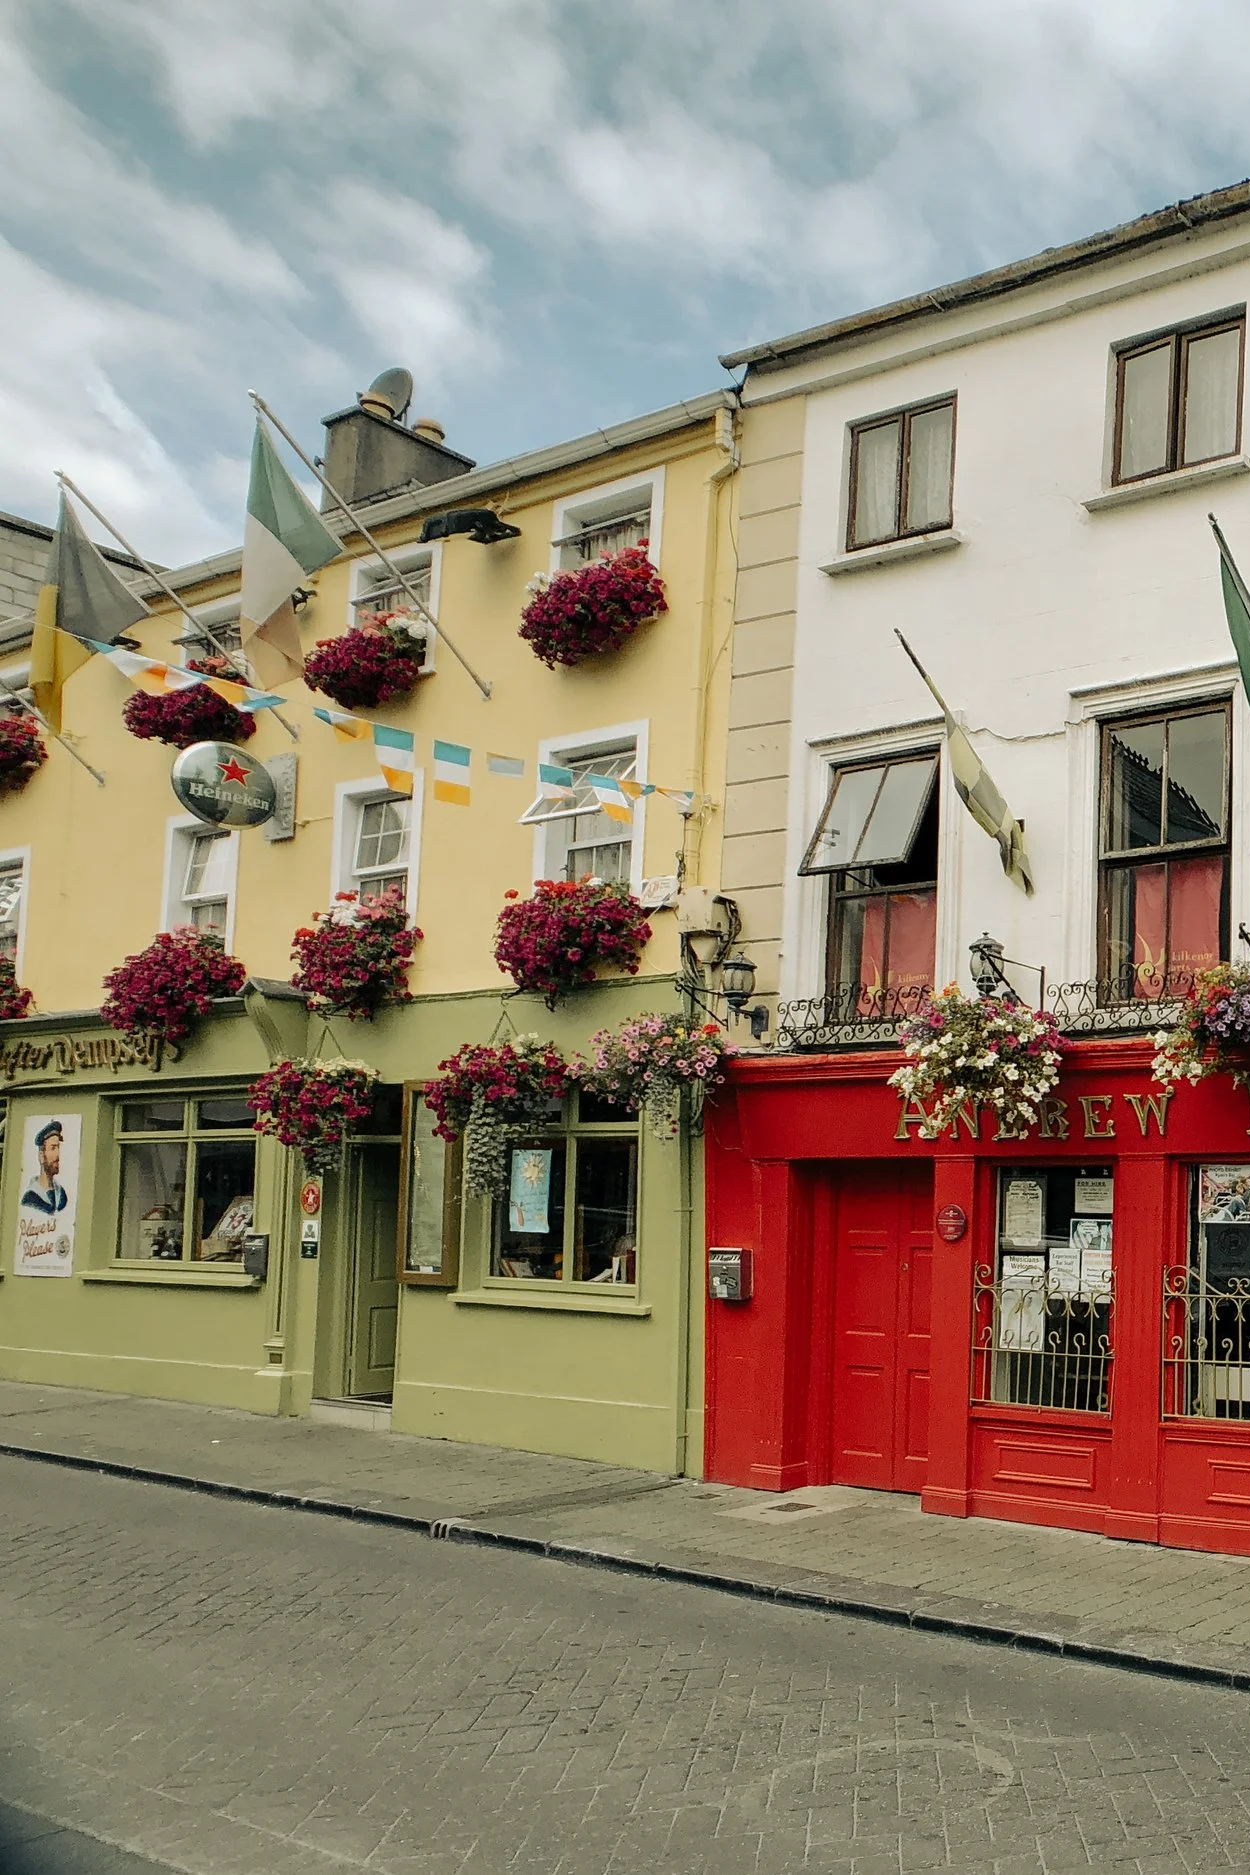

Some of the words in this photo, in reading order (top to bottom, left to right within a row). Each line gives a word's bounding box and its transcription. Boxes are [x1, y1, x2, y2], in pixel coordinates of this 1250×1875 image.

[189, 781, 270, 811] Heineken
[1172, 950, 1213, 961] kilkenny
[1009, 1256, 1040, 1264] Musicians
[1011, 1263, 1038, 1271] Welcome
